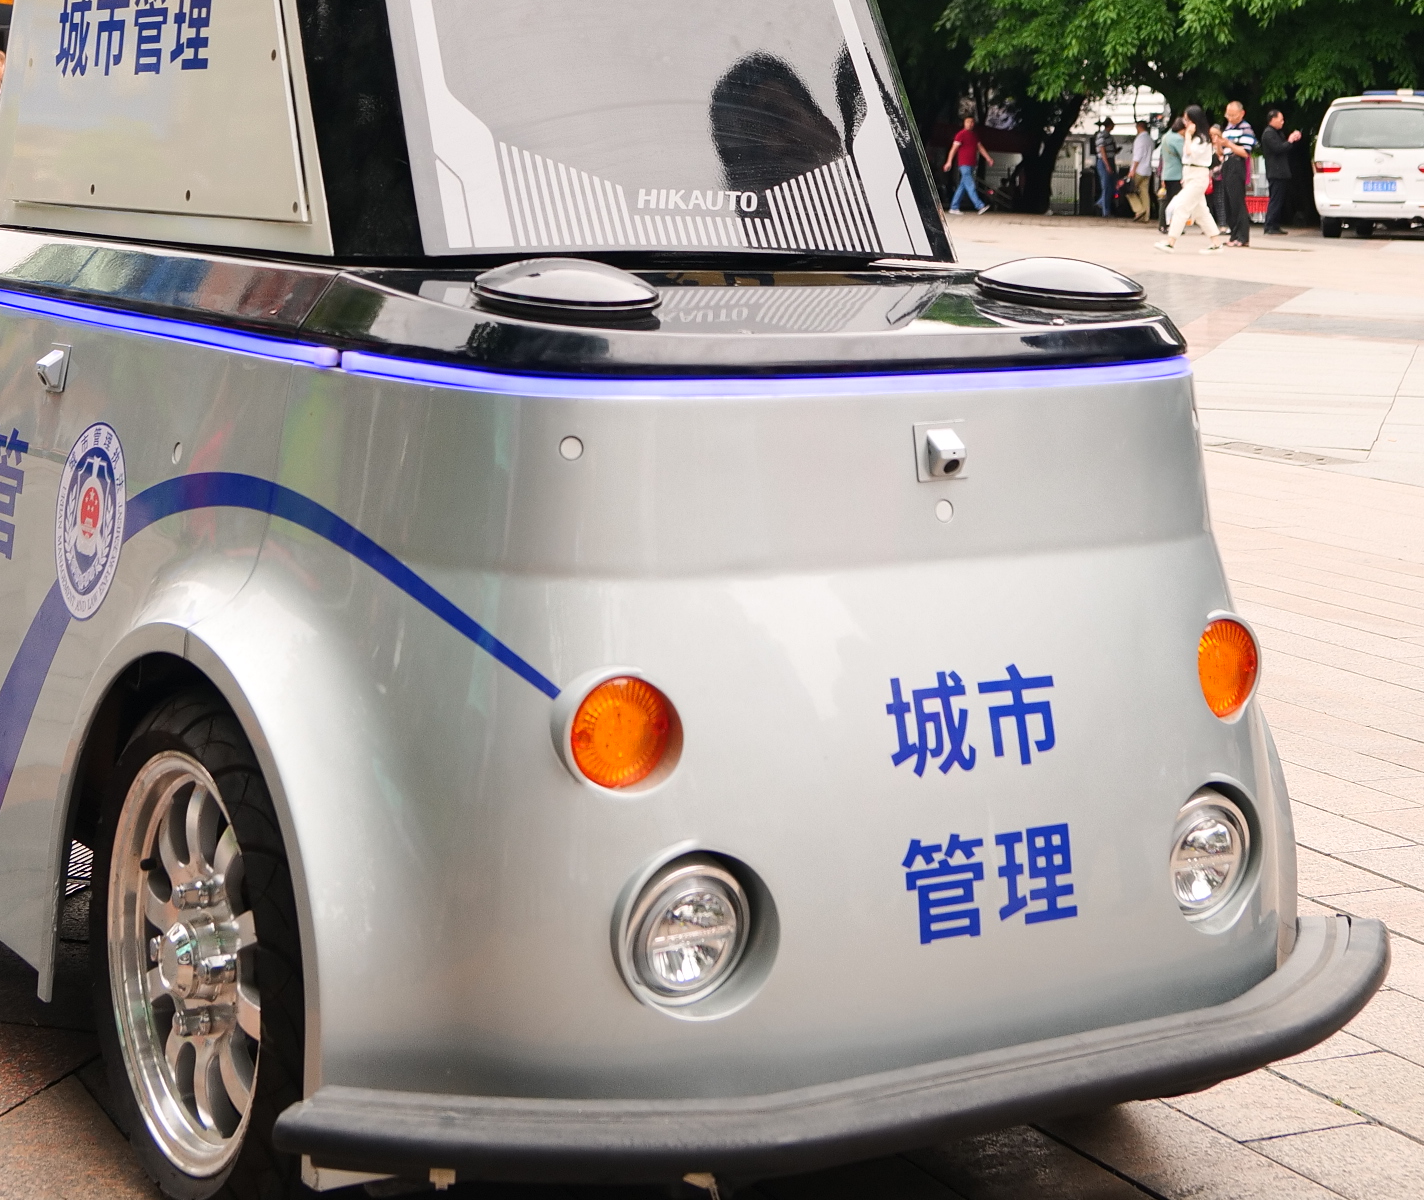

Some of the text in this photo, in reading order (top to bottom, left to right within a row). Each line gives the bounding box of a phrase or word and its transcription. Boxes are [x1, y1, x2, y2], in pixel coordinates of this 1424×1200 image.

[637, 188, 758, 212] HIKAUTO
[886, 662, 1057, 778] 城市
[901, 822, 1078, 945] 管理
